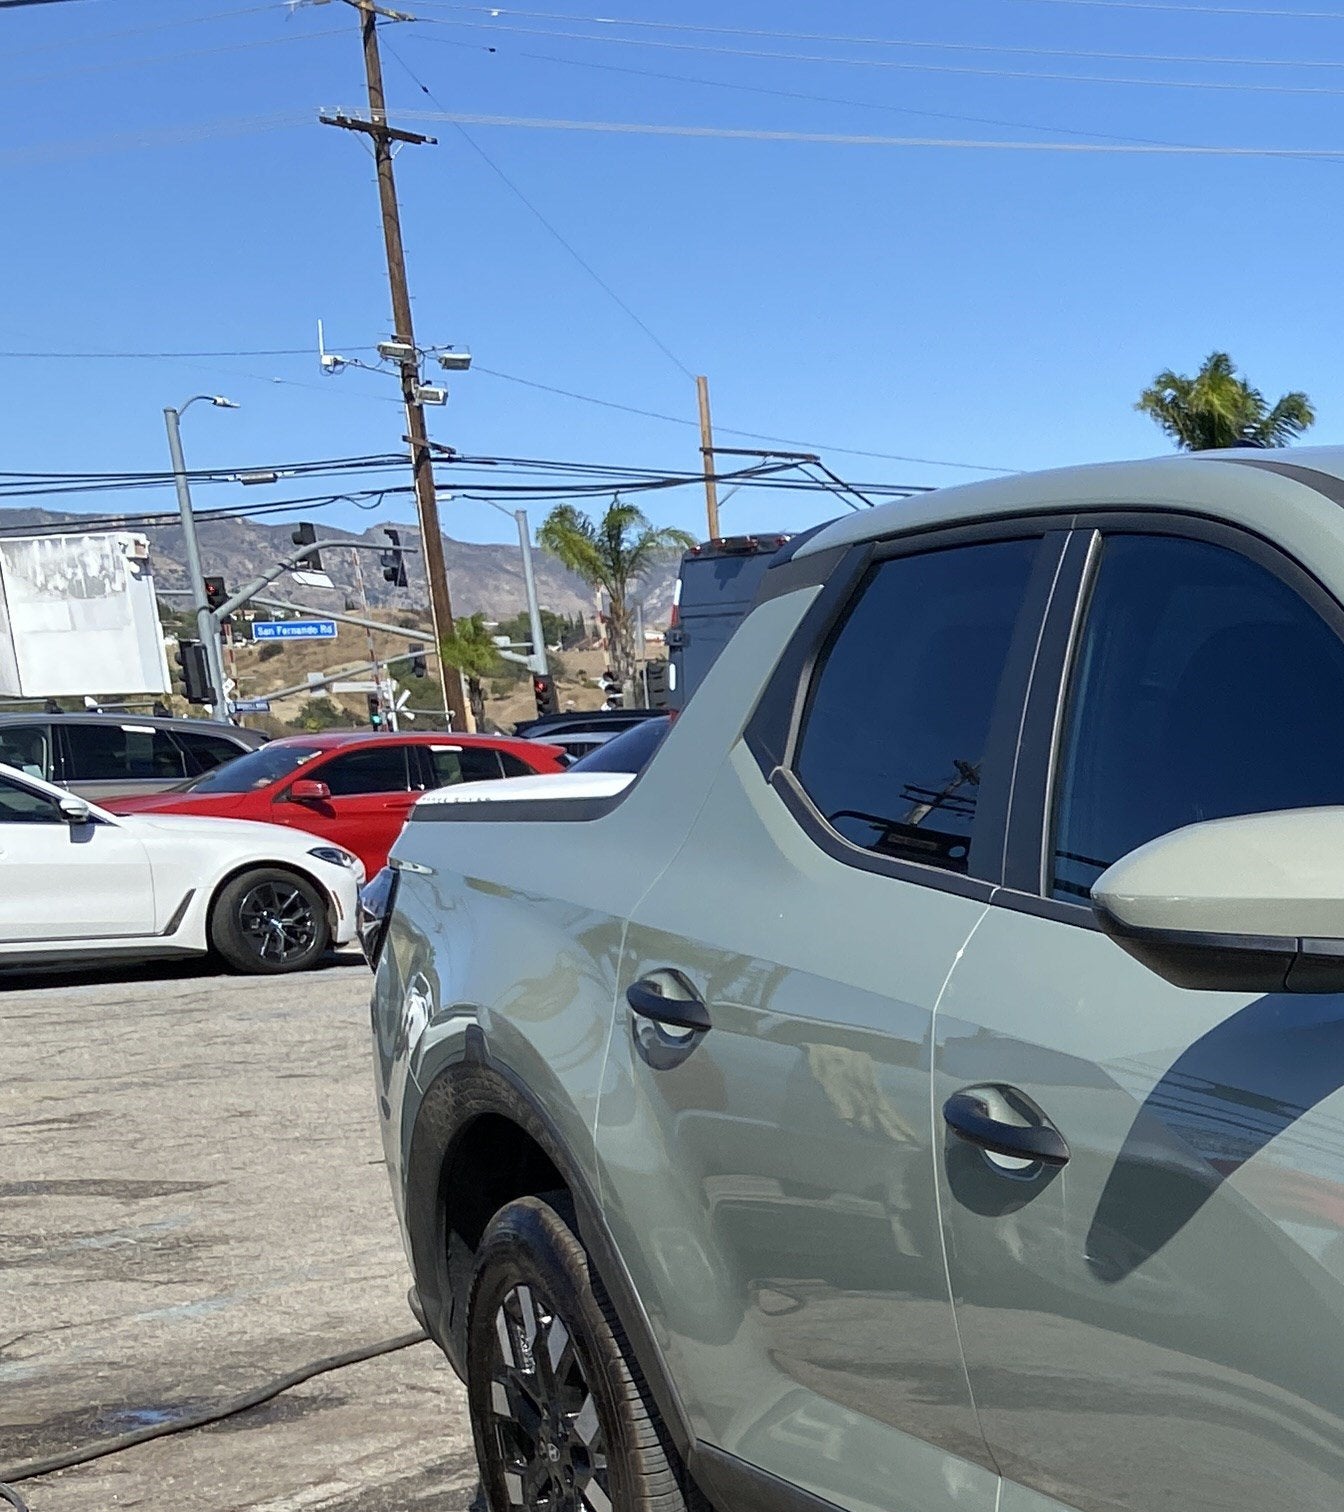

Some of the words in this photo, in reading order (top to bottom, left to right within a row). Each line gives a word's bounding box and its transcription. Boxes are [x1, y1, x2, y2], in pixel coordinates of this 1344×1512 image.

[257, 626, 275, 636] San
[277, 625, 319, 636] Fernando
[320, 624, 333, 634] Rd
